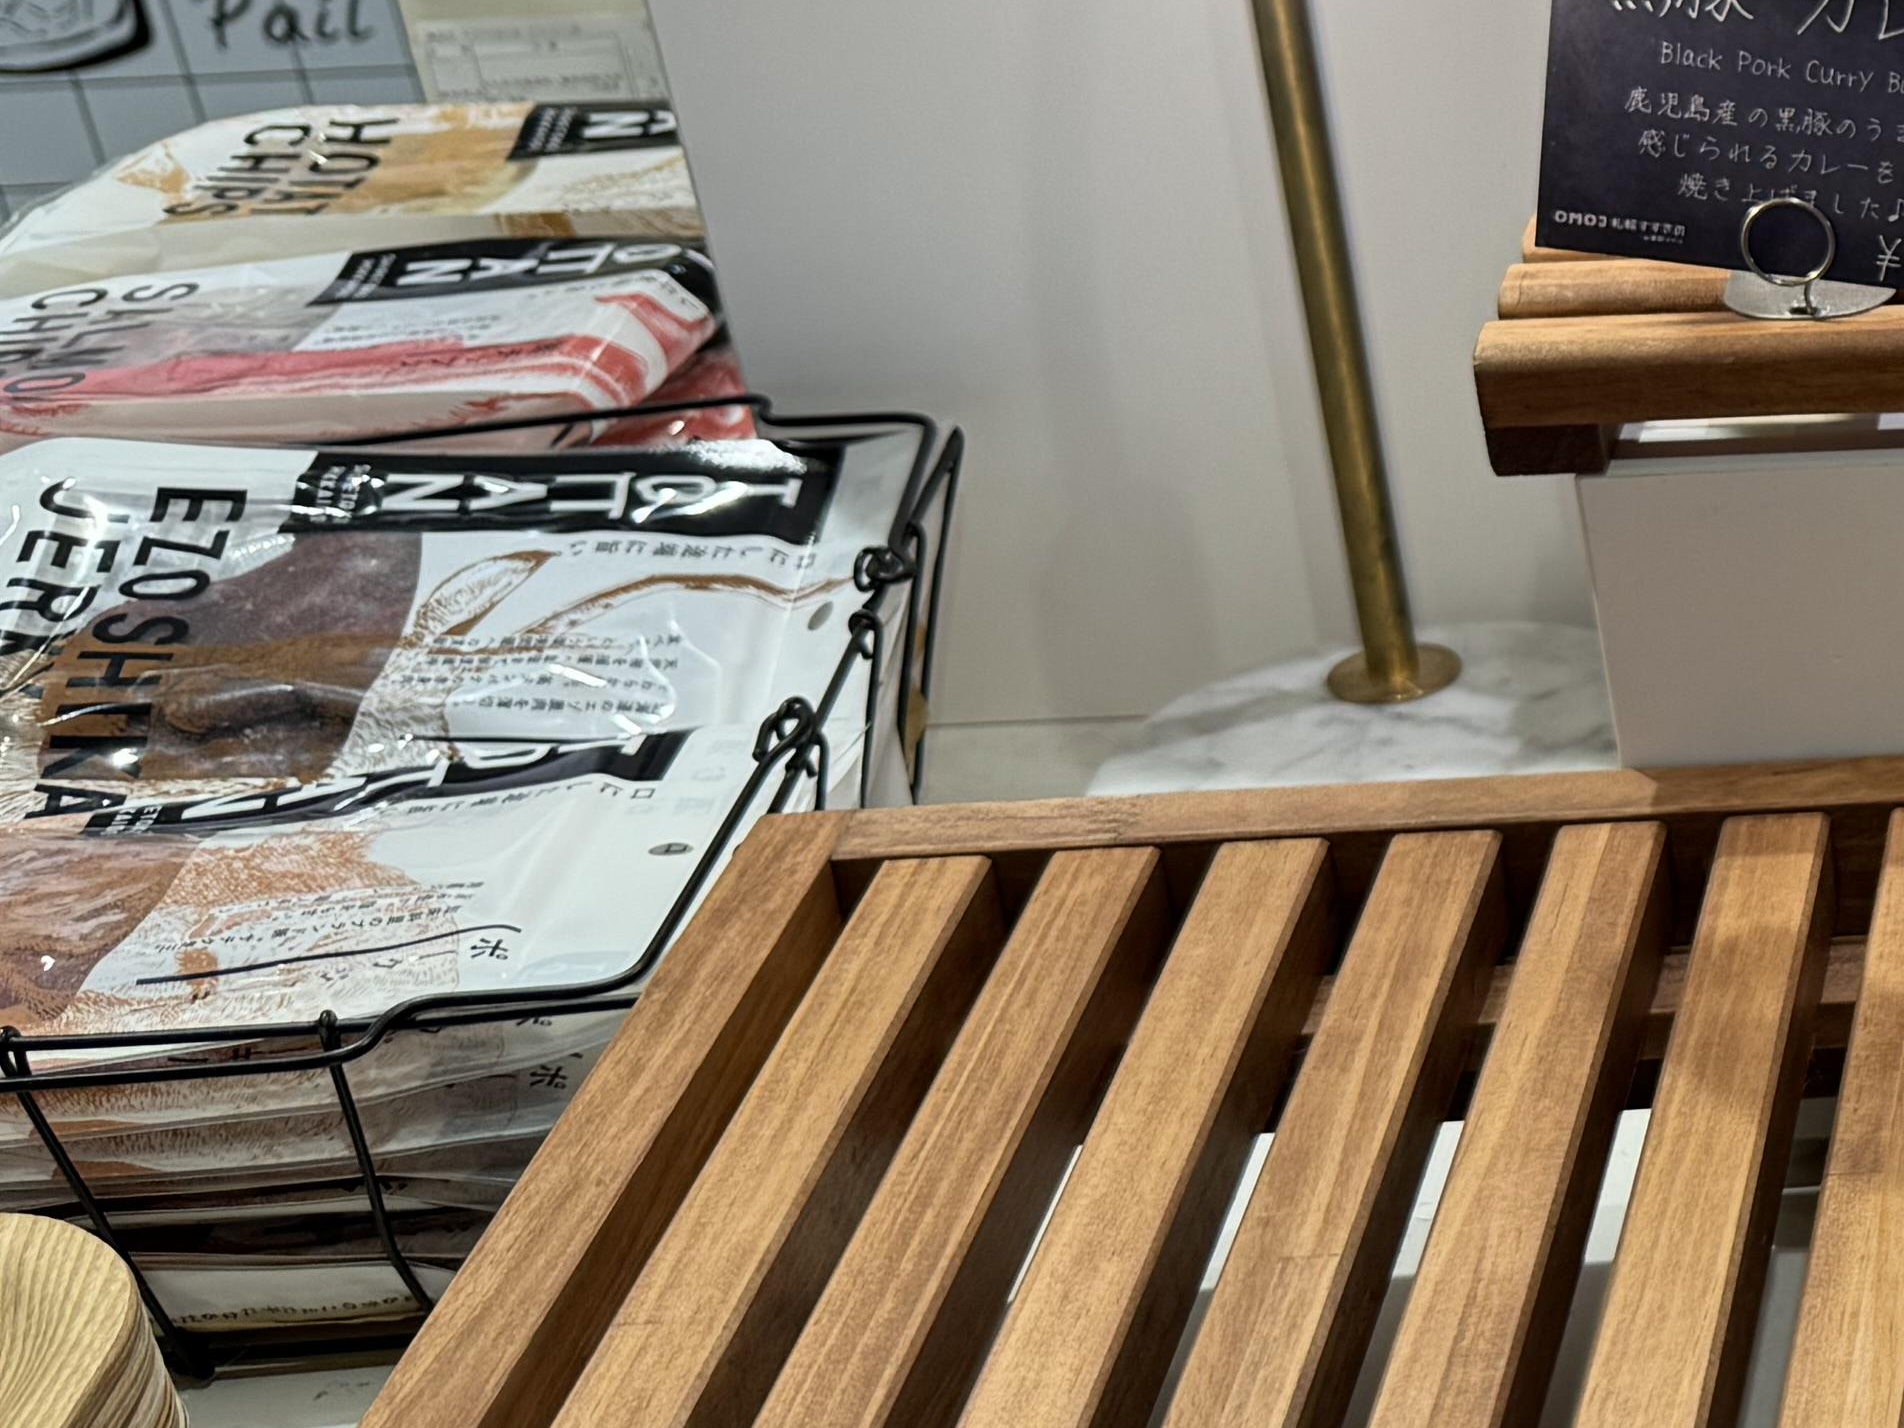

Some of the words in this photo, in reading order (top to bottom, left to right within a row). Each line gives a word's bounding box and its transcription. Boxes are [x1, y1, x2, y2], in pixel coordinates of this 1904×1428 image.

[1661, 41, 1721, 71] Black
[1738, 49, 1790, 80] Pork
[1805, 62, 1874, 92] Curry
